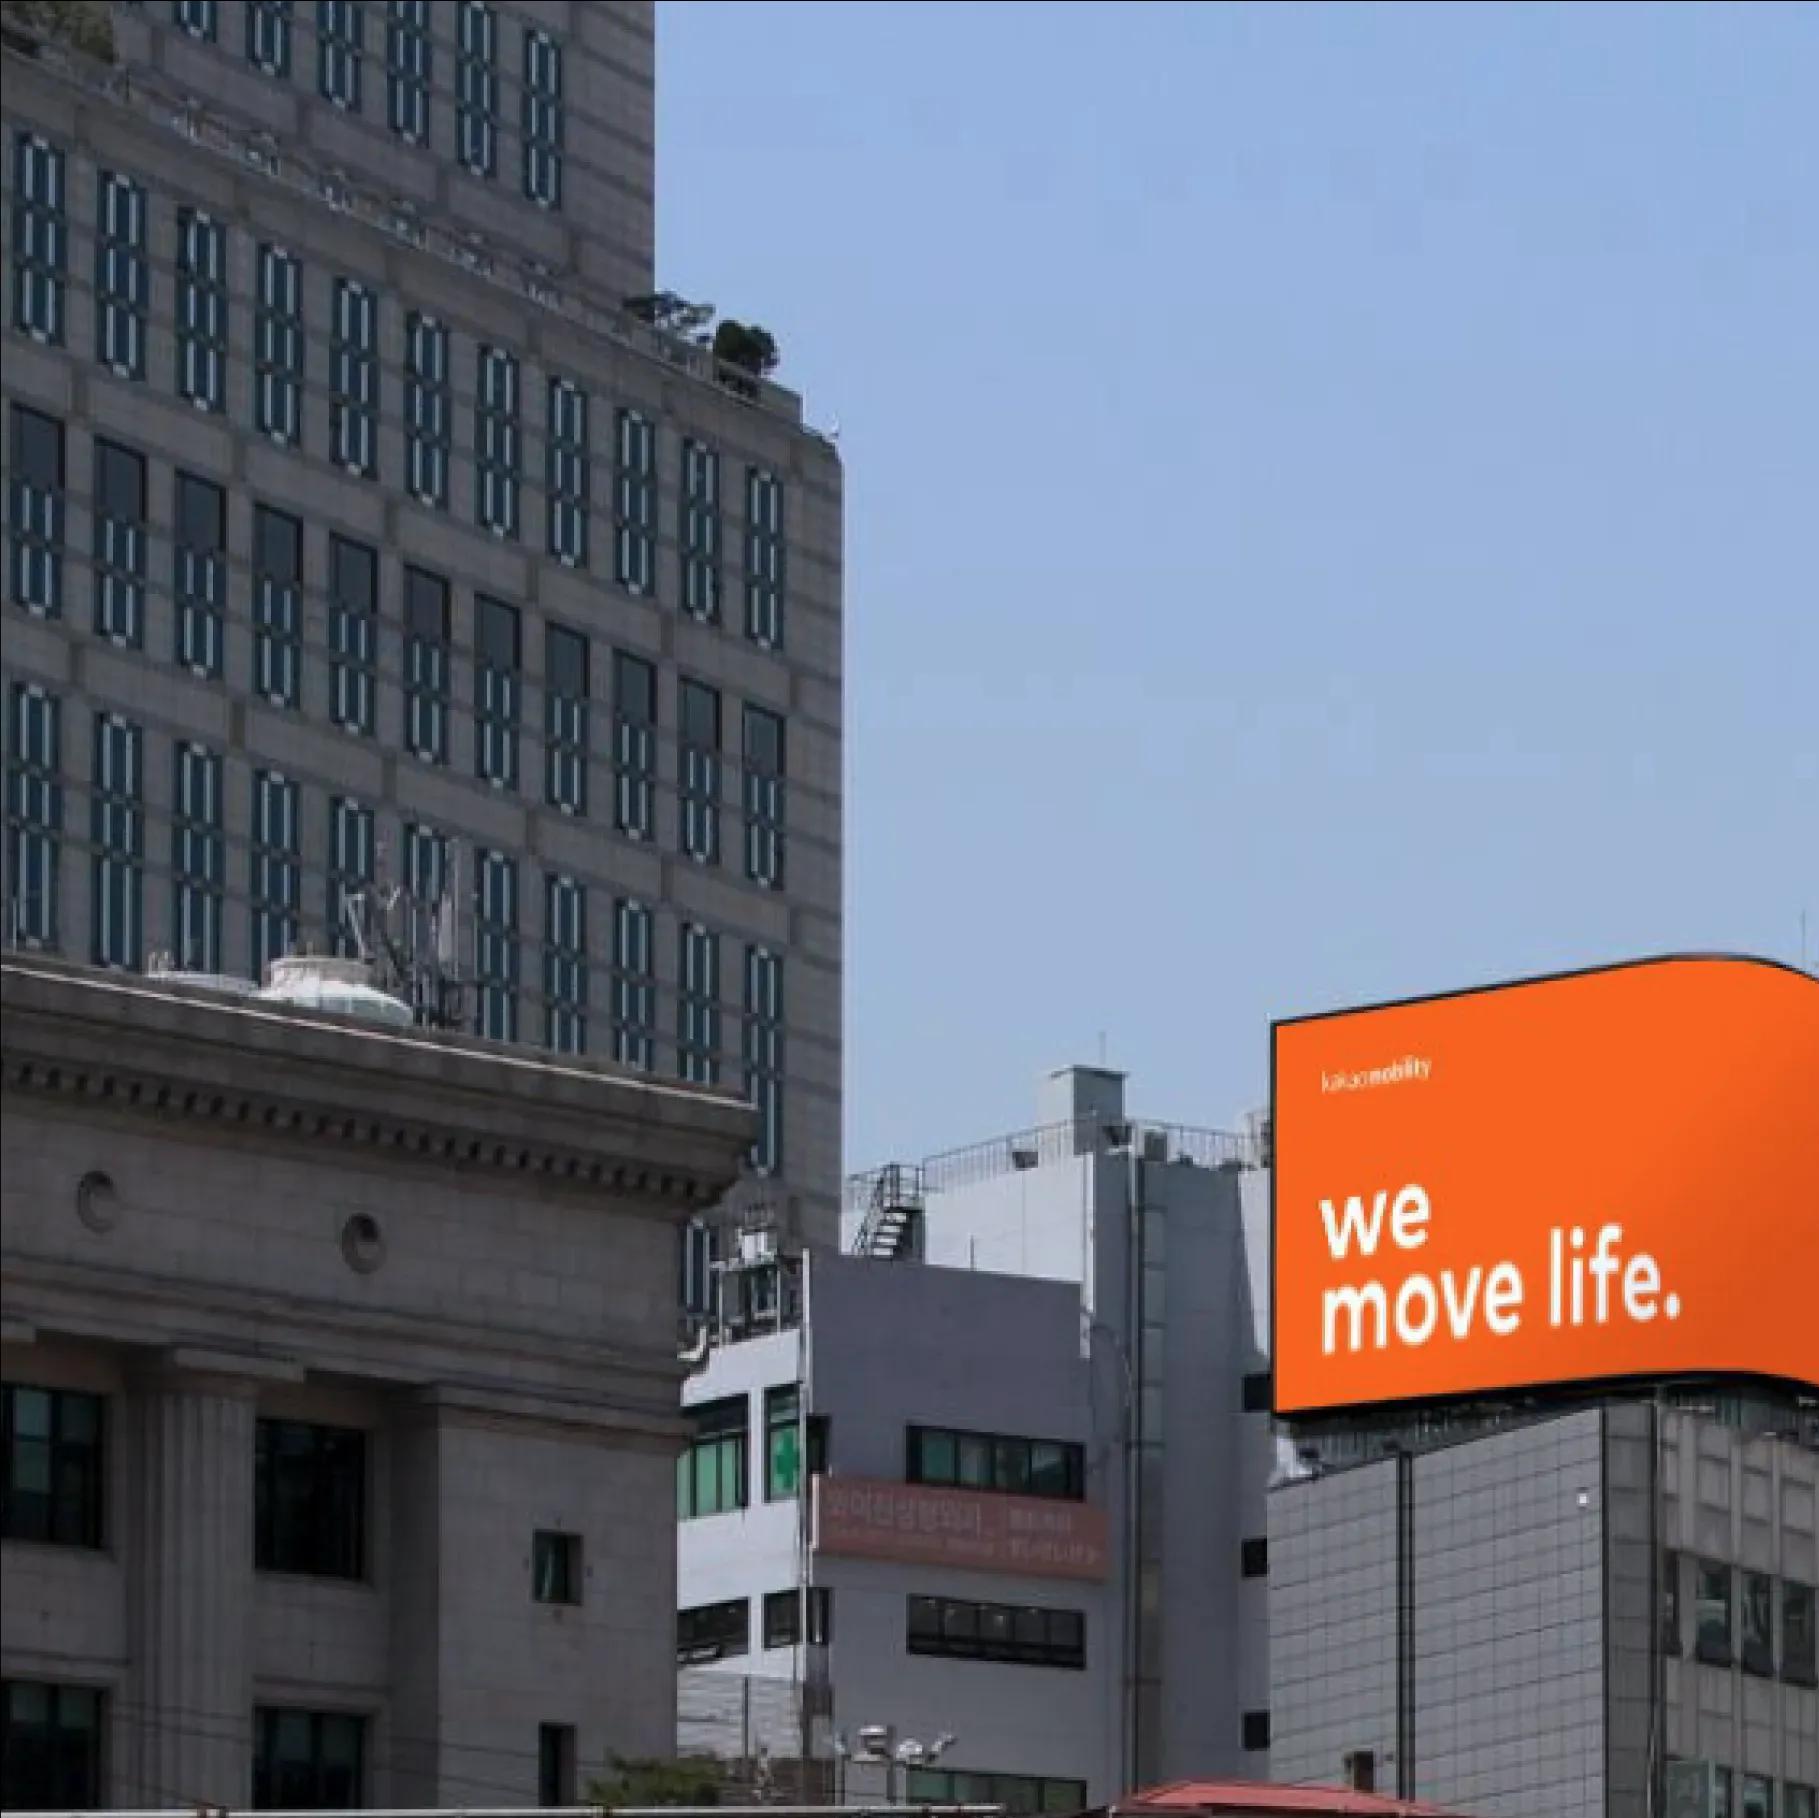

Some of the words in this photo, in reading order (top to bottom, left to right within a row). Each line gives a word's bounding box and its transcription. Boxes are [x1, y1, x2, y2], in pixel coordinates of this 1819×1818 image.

[1321, 1054, 1432, 1093] kakaomobility
[1319, 1183, 1431, 1261] we
[1321, 1260, 1524, 1356] move
[1548, 1222, 1682, 1328] life.
